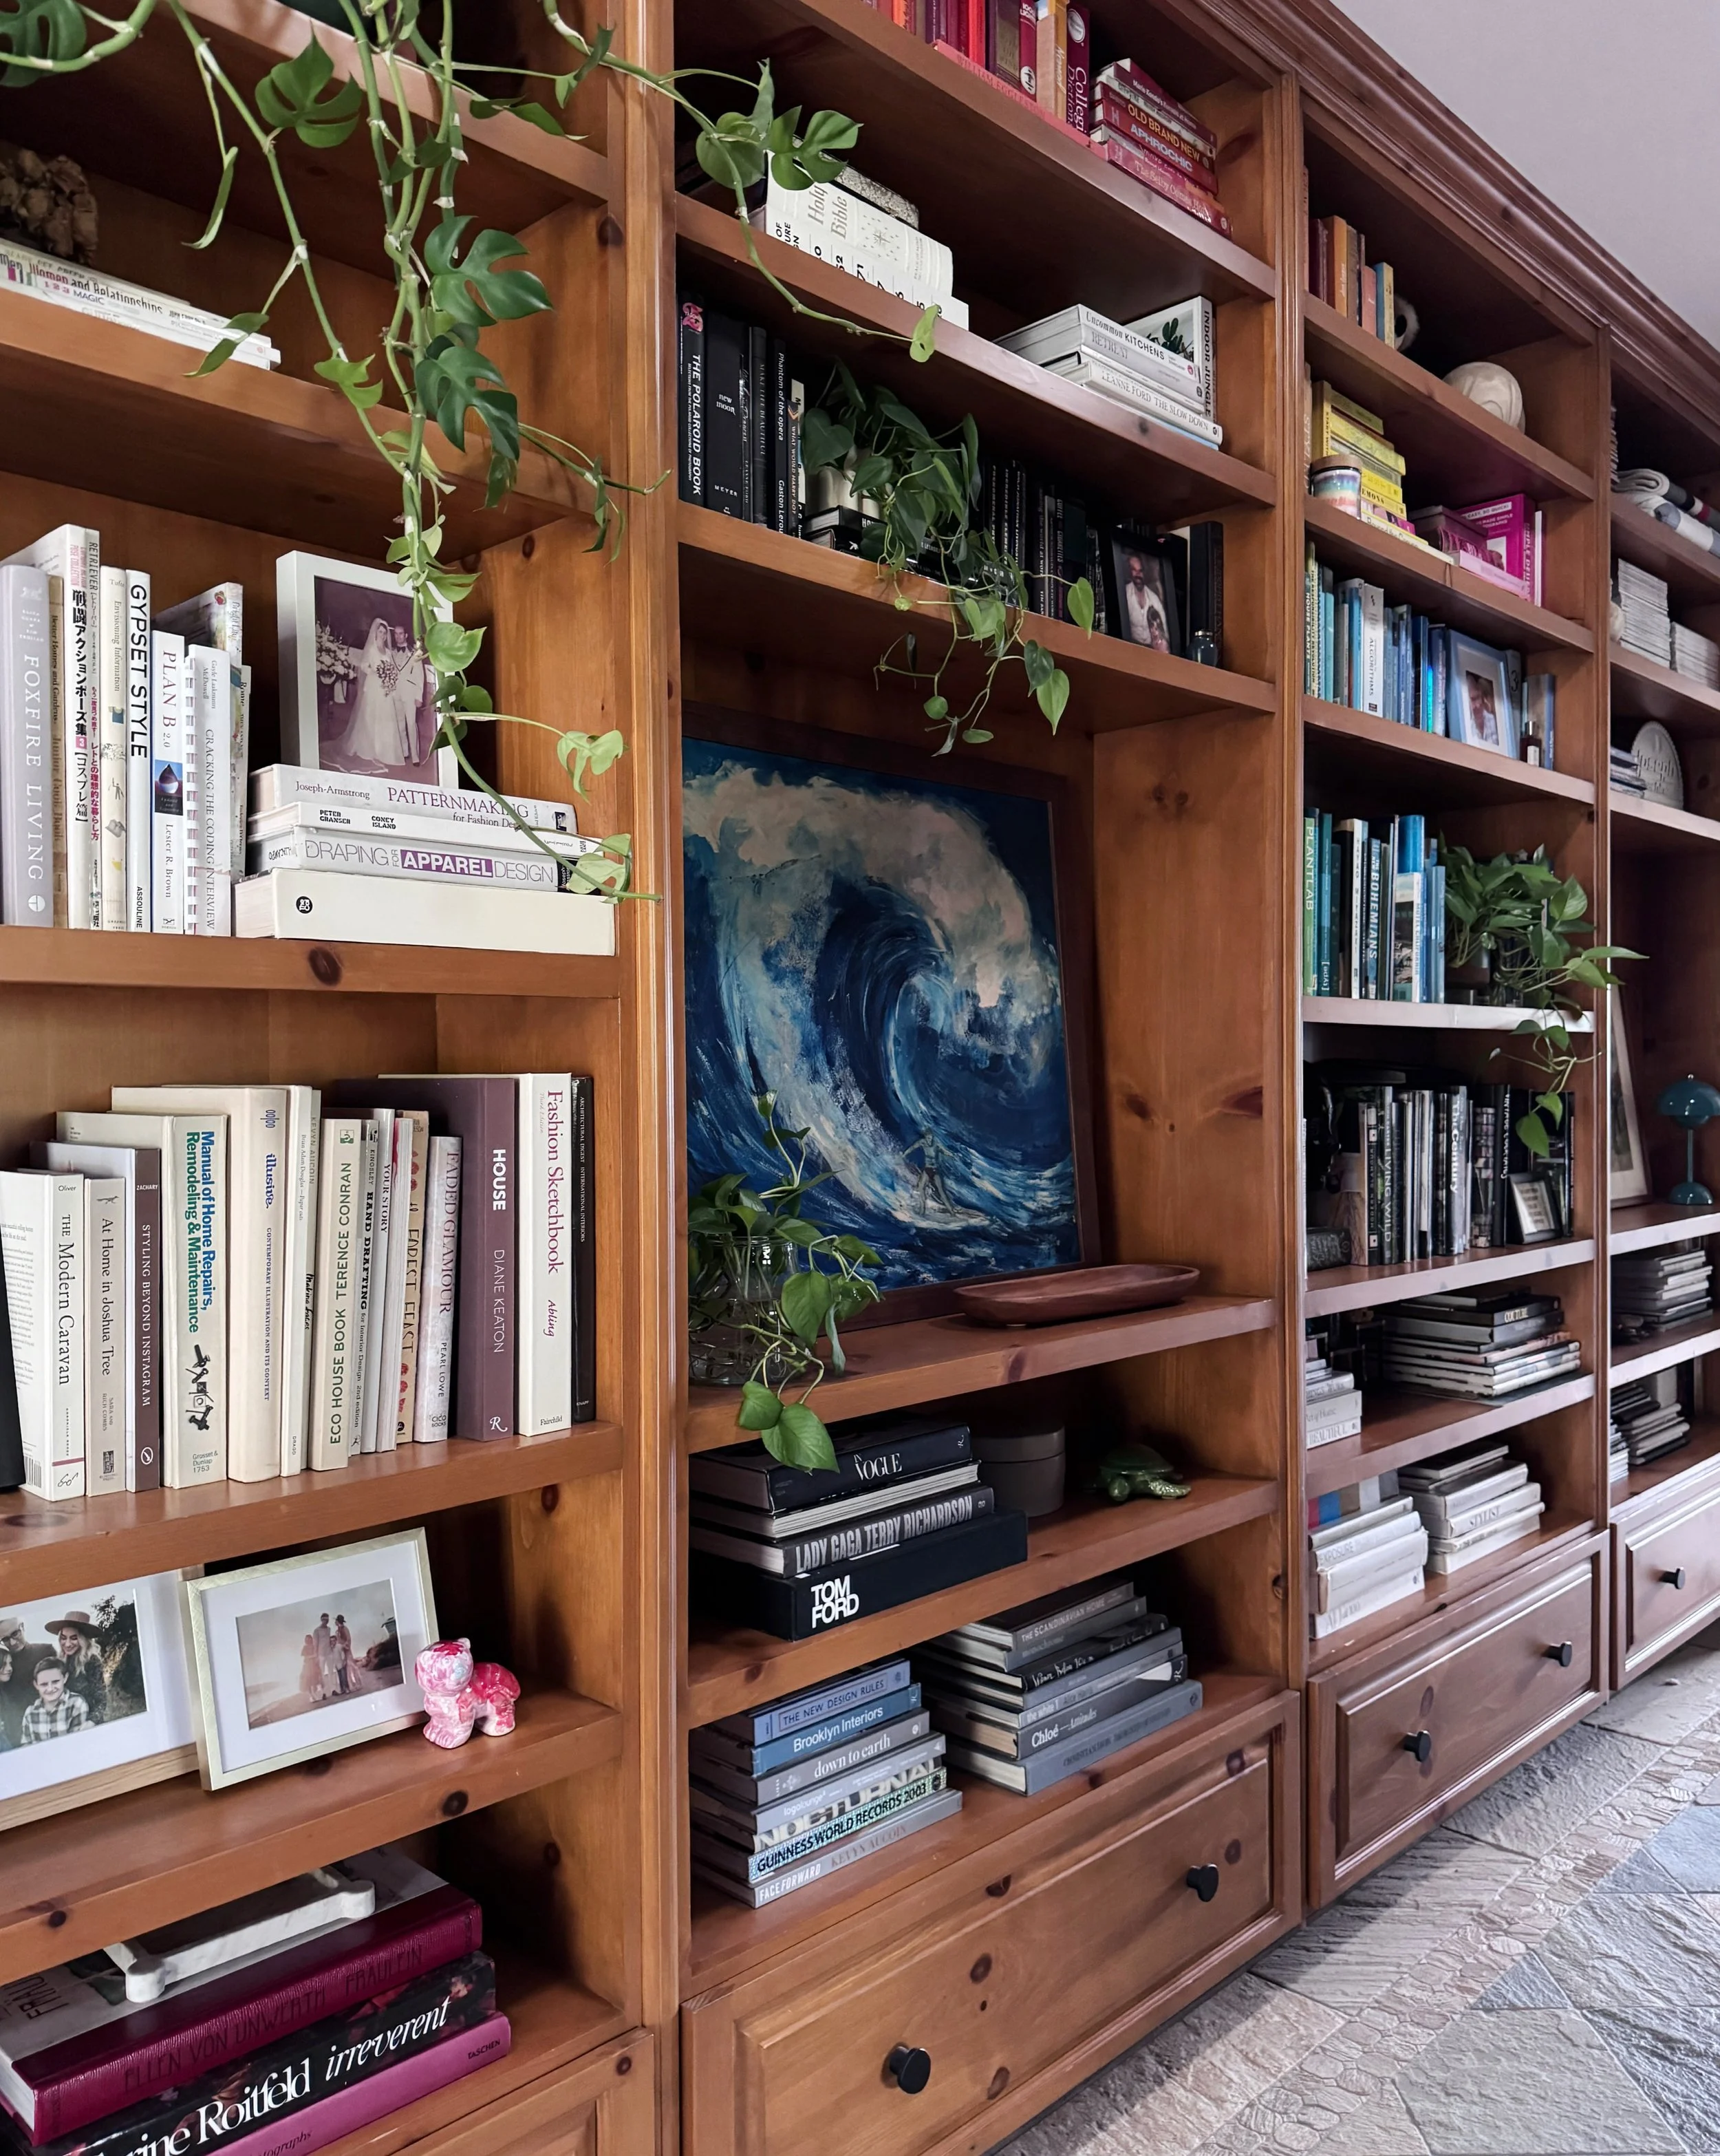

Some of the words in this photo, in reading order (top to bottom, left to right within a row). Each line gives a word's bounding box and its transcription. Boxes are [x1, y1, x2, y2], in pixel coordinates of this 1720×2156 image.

[1127, 104, 1147, 124] OLD
[1148, 117, 1180, 147] BRAND
[1180, 140, 1200, 162] NEW
[1130, 123, 1193, 172] APHROCHIC
[807, 185, 828, 226] Holy
[830, 195, 848, 240] Bible
[71, 278, 90, 292] and
[73, 289, 105, 306] MAGIC
[1086, 310, 1123, 339] Uncommon
[1124, 332, 1165, 360] KITCHENS
[692, 354, 701, 379] THE
[716, 401, 736, 416] moon
[718, 394, 733, 404] new
[778, 390, 785, 400] of
[1101, 371, 1131, 394] LEANNE
[1132, 385, 1152, 403] FORD
[1154, 396, 1168, 412] THE
[1168, 403, 1187, 420] SLOW
[1188, 413, 1209, 431] DOWN
[692, 383, 701, 453] POLAROID
[692, 457, 701, 495] BOOK
[714, 484, 738, 497] MEYER
[89, 542, 98, 590] RETRIEVER
[111, 600, 122, 645] Envisioning
[130, 584, 147, 679] GYPSET
[113, 648, 122, 692] Information
[162, 650, 177, 707] PLAN
[24, 654, 41, 767] FOXFIRE
[130, 685, 148, 758] STYLE
[162, 712, 177, 729] B
[163, 732, 171, 748] 2.0
[206, 728, 215, 791] CRACKING
[206, 793, 215, 817] THE
[296, 781, 370, 800] Joseph-Armstrong
[26, 783, 43, 880] LIVING
[319, 809, 341, 818] PETER
[319, 815, 351, 824] GRANSER
[372, 822, 397, 830] ISLAND
[165, 824, 173, 853] Lester
[165, 855, 173, 866] R.
[206, 818, 215, 865] CODING
[165, 868, 173, 898] Brown
[305, 840, 389, 866] DRAPING
[391, 849, 400, 867] FOR
[402, 851, 493, 877] APPAREL
[494, 860, 554, 884] DESIGN
[1305, 825, 1315, 910] PLANTLAB
[206, 870, 215, 930] INTERVIEW
[1368, 873, 1380, 959] BOHEMIANS
[547, 1090, 564, 1161] Fashion
[186, 1131, 200, 1221] Remodeling
[202, 1131, 215, 1184] Manual
[382, 1164, 391, 1194] YOUR
[1384, 1147, 1392, 1197] LIVING
[58, 1184, 76, 1193] Oliver
[202, 1184, 215, 1202] of
[338, 1162, 352, 1226] CONRAN
[444, 1151, 460, 1216] FADED
[493, 1149, 506, 1211] HOUSE
[61, 1215, 71, 1237] THE
[102, 1217, 114, 1235] At
[187, 1221, 200, 1235] &
[202, 1204, 215, 1248] Home
[365, 1191, 374, 1232] HAND
[380, 1197, 389, 1233] STORY
[547, 1166, 564, 1274] Sketchbook
[1383, 1202, 1391, 1243] WILD
[102, 1238, 114, 1278] Home
[142, 1224, 151, 1278] STYLING
[335, 1230, 350, 1301] TERENCE
[439, 1219, 456, 1315] GLAMOUR
[493, 1249, 506, 1294] DIANE
[58, 1242, 76, 1310] Modern
[102, 1281, 112, 1294] in
[186, 1237, 200, 1334] Maintenance
[200, 1249, 215, 1312] Repairs,
[360, 1237, 372, 1310] DRAFTING
[101, 1297, 114, 1342] Joshua
[142, 1281, 151, 1332] BEYOND
[493, 1298, 506, 1354] KEATON
[543, 1299, 555, 1338] Abling
[1504, 1308, 1529, 1324] COUTURE
[58, 1314, 76, 1386] Caravan
[334, 1308, 346, 1352] BOOK
[358, 1325, 366, 1354] Interior
[102, 1345, 115, 1376] Tree
[142, 1335, 151, 1407] INSTAGRAM
[332, 1356, 344, 1409] HOUSE
[356, 1354, 364, 1381] Design
[330, 1413, 342, 1444] ECO
[539, 1415, 564, 1427] Fairchild
[192, 1451, 213, 1460] Grosset
[193, 1458, 213, 1466] Dunlap
[193, 1464, 211, 1473] 1753
[854, 1452, 903, 1481] VOGUE
[795, 1537, 828, 1573] LADY
[830, 1530, 863, 1561] GAGA
[864, 1519, 901, 1554] TERRY
[903, 1495, 974, 1541] RICHARDSON
[810, 1575, 851, 1607] TOM
[811, 1593, 860, 1629] FORD
[1021, 1631, 1033, 1643] THE
[1033, 1607, 1086, 1636] SCANDINAVIAN
[1086, 1597, 1106, 1613] HOME
[783, 1712, 800, 1726] THE
[802, 1704, 824, 1719] NEW
[826, 1692, 858, 1709] DESIGN
[861, 1680, 884, 1697] RULES
[793, 1722, 841, 1753] Brooklyn
[841, 1707, 883, 1733] Interiors
[1031, 1725, 1060, 1749] Chloé
[813, 1755, 846, 1778] down
[847, 1751, 860, 1767] to
[861, 1734, 891, 1760] earth
[757, 1835, 814, 1872] GUINNESS
[814, 1817, 854, 1844] WORLD
[855, 1797, 902, 1825] RECORDS
[903, 1783, 927, 1803] 2003
[758, 1883, 780, 1901] FACE
[781, 1863, 821, 1892] FORWARD
[195, 2062, 312, 2146] Roitfeld
[325, 1996, 453, 2083] irreverent
[467, 2038, 502, 2060] TASCHEN
